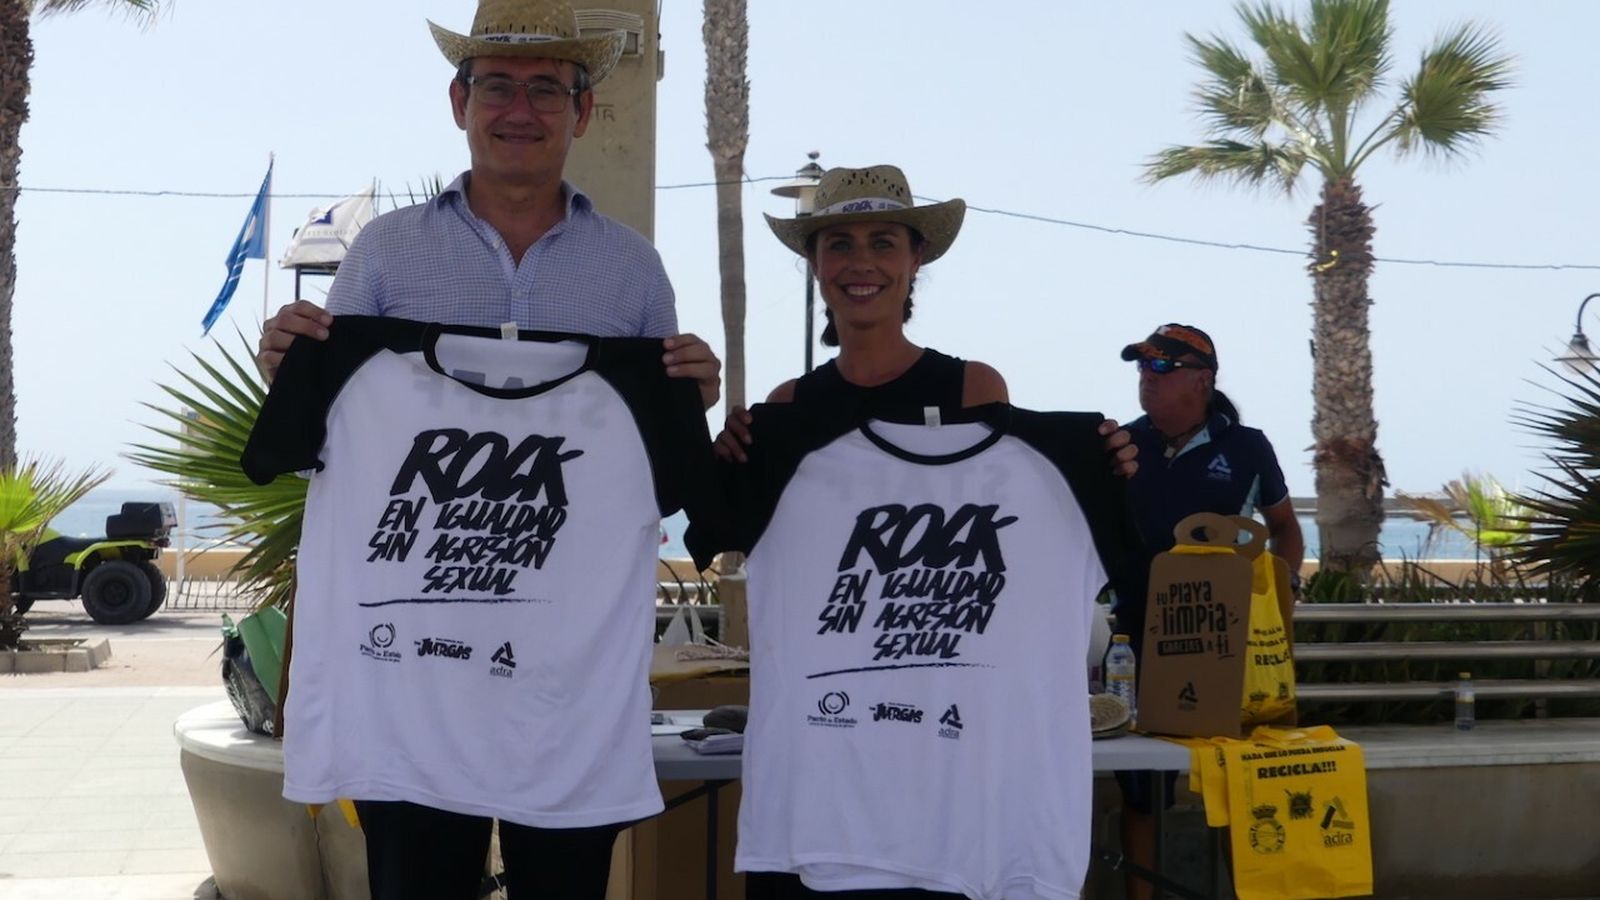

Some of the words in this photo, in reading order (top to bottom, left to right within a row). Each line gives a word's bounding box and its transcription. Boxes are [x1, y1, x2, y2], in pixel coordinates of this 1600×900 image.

[389, 428, 584, 506] ROCK
[377, 496, 428, 532] EN
[433, 500, 567, 540] IGUALDAD
[366, 529, 419, 562] SIN
[837, 503, 1019, 576] ROCK
[421, 565, 519, 596] SEXUAL
[827, 569, 873, 605] EN
[880, 569, 1006, 606] IGUALDAD
[816, 601, 867, 635] SIN
[872, 632, 962, 661] SEXUAL
[490, 666, 513, 678] adra
[938, 727, 960, 739] adra
[1257, 760, 1337, 779] RECICLA!!!
[1324, 831, 1353, 848] adra
